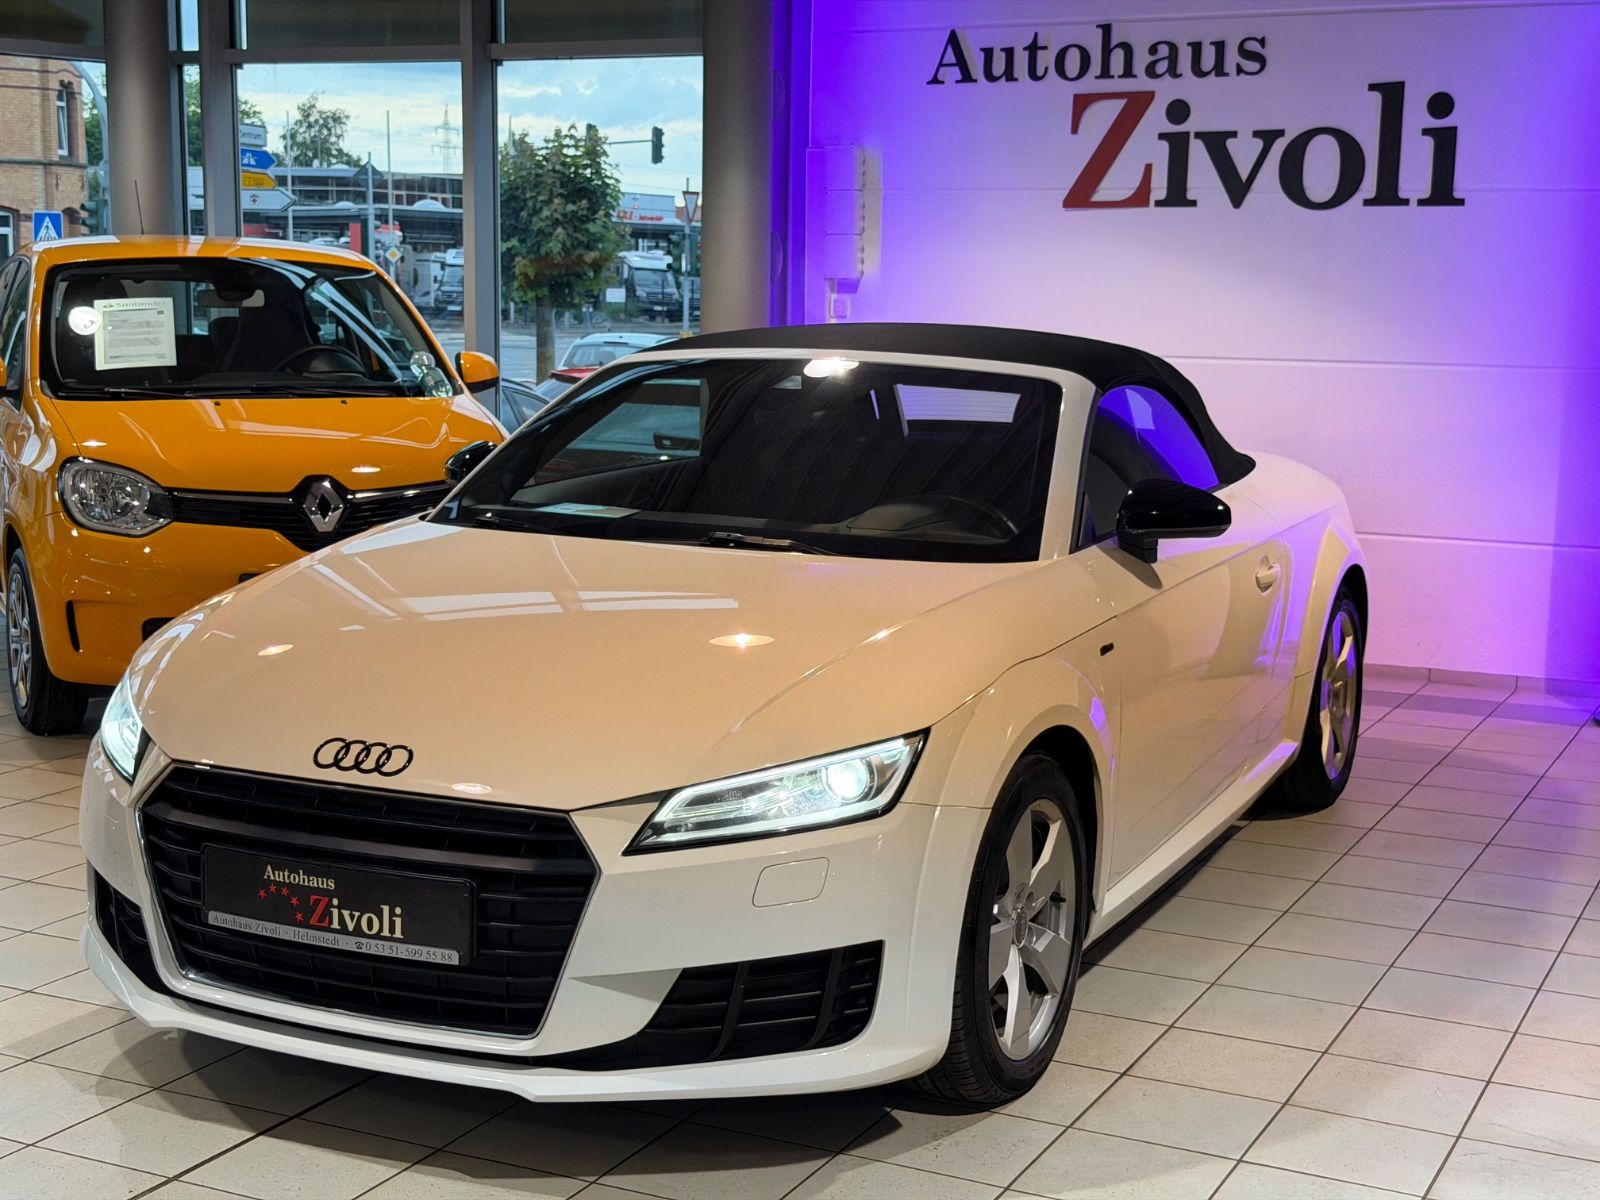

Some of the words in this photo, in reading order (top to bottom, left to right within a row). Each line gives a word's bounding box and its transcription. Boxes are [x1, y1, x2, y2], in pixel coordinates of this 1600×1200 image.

[926, 23, 1267, 85] Autohaus
[1062, 81, 1465, 211] Zivoli
[263, 864, 335, 890] Autohaus
[212, 913, 252, 930] Autohaus
[254, 922, 281, 936] Zivoli
[293, 929, 340, 947] Helmstedt
[309, 894, 403, 939] Zivoli
